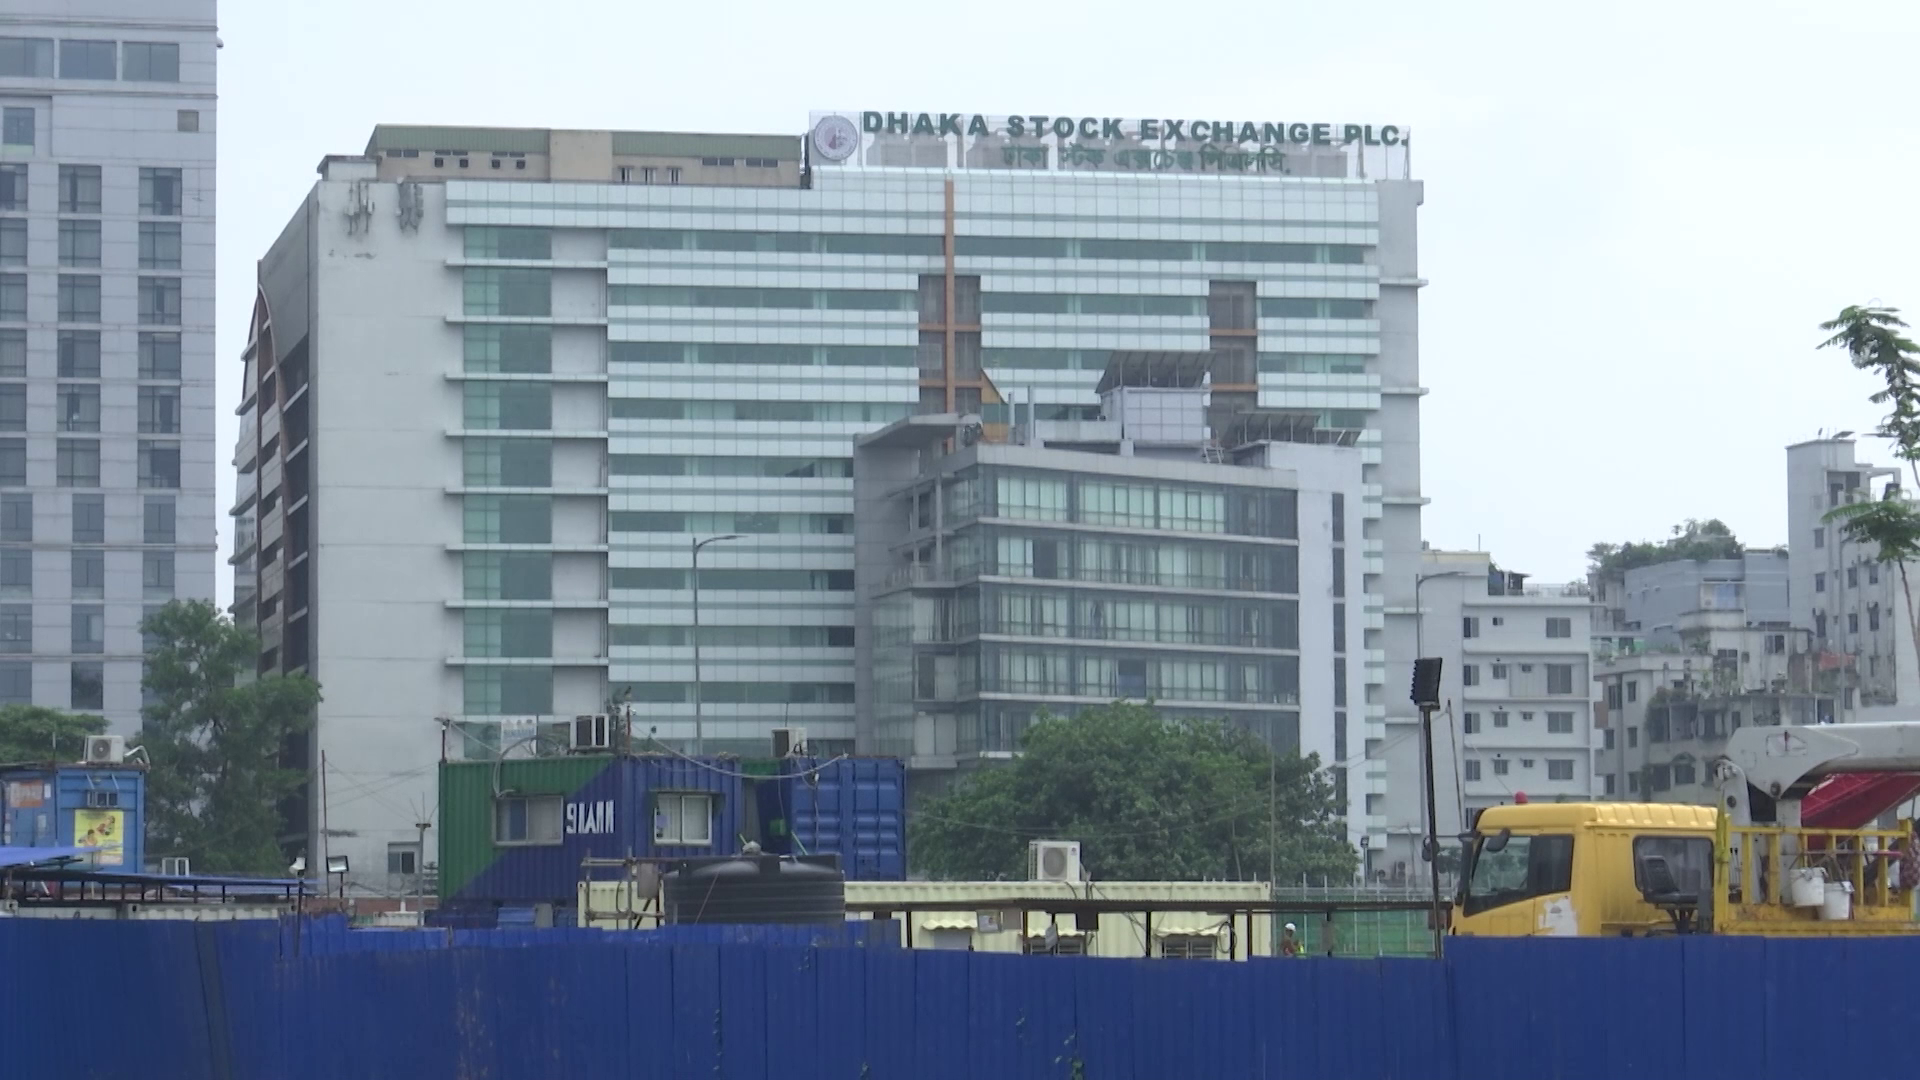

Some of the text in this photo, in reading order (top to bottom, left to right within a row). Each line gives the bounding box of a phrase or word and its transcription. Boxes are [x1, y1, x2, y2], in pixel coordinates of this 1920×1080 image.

[863, 111, 1408, 147] DHAKA STOCK EXCHANGE PLC.
